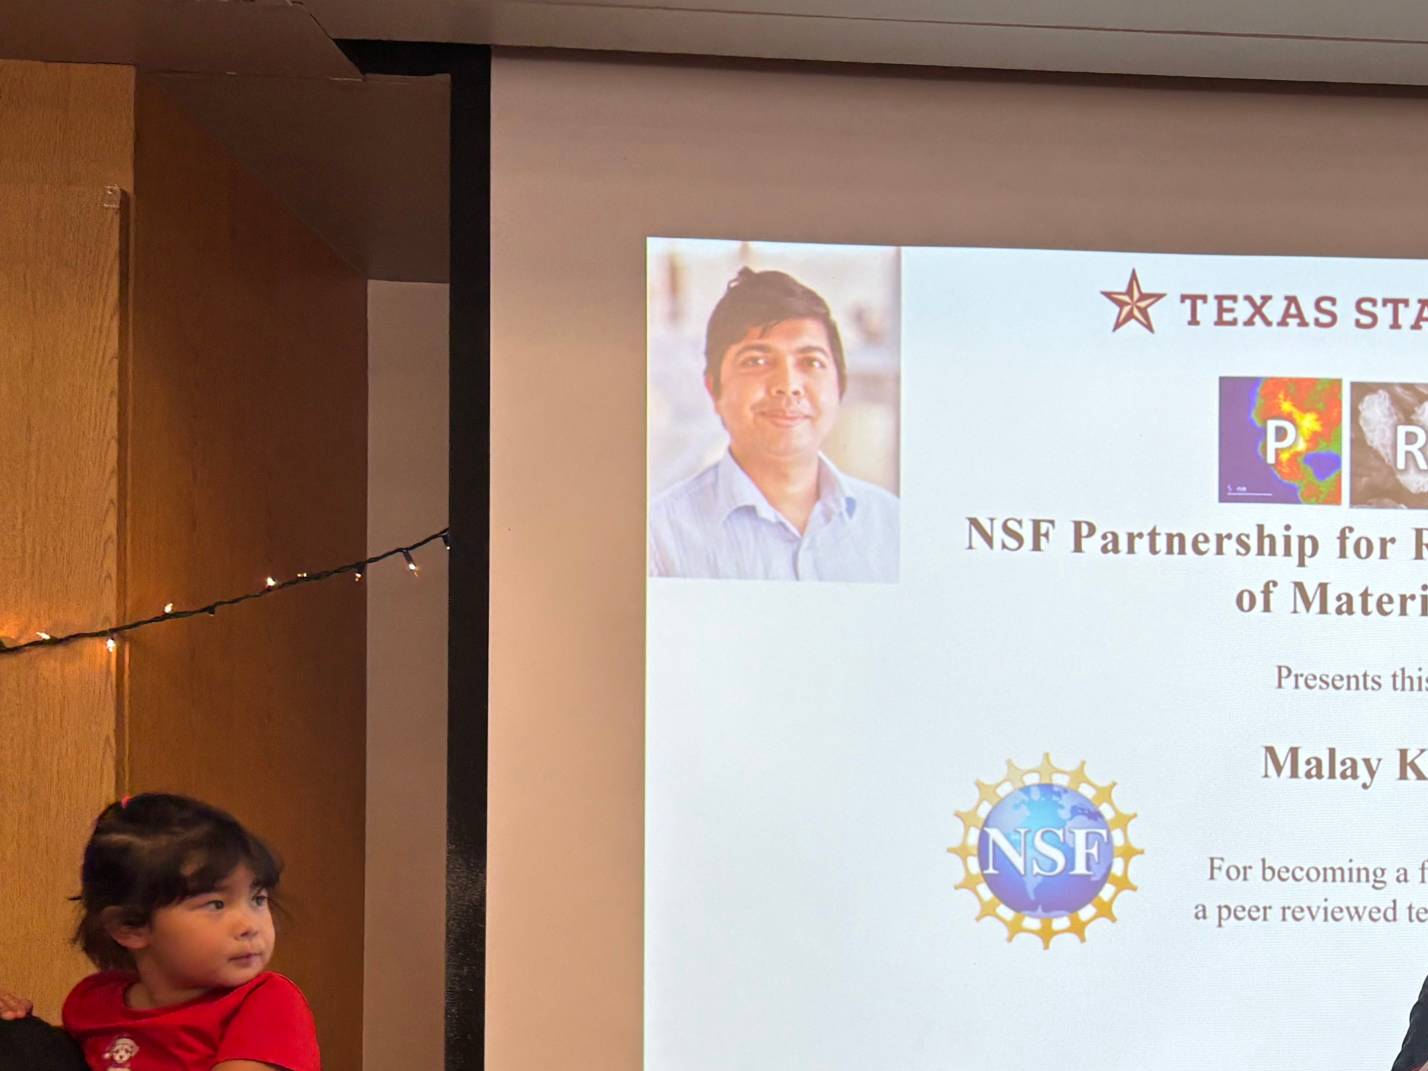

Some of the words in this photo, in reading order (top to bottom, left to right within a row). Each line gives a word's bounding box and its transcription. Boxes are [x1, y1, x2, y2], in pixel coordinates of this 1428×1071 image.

[1180, 293, 1338, 329] TEXAS
[964, 516, 1055, 552] NSF
[1071, 520, 1320, 568] Partnership
[1336, 526, 1396, 560] for
[1235, 579, 1278, 613] of
[1276, 665, 1382, 692] Presents
[1261, 744, 1382, 790] Malay
[983, 826, 1108, 877] NSF
[1208, 857, 1253, 882] For
[1261, 858, 1387, 889] becoming
[1395, 866, 1409, 884] a
[1193, 904, 1208, 921] a
[1217, 902, 1273, 932] peer
[1280, 898, 1399, 923] reviewed
